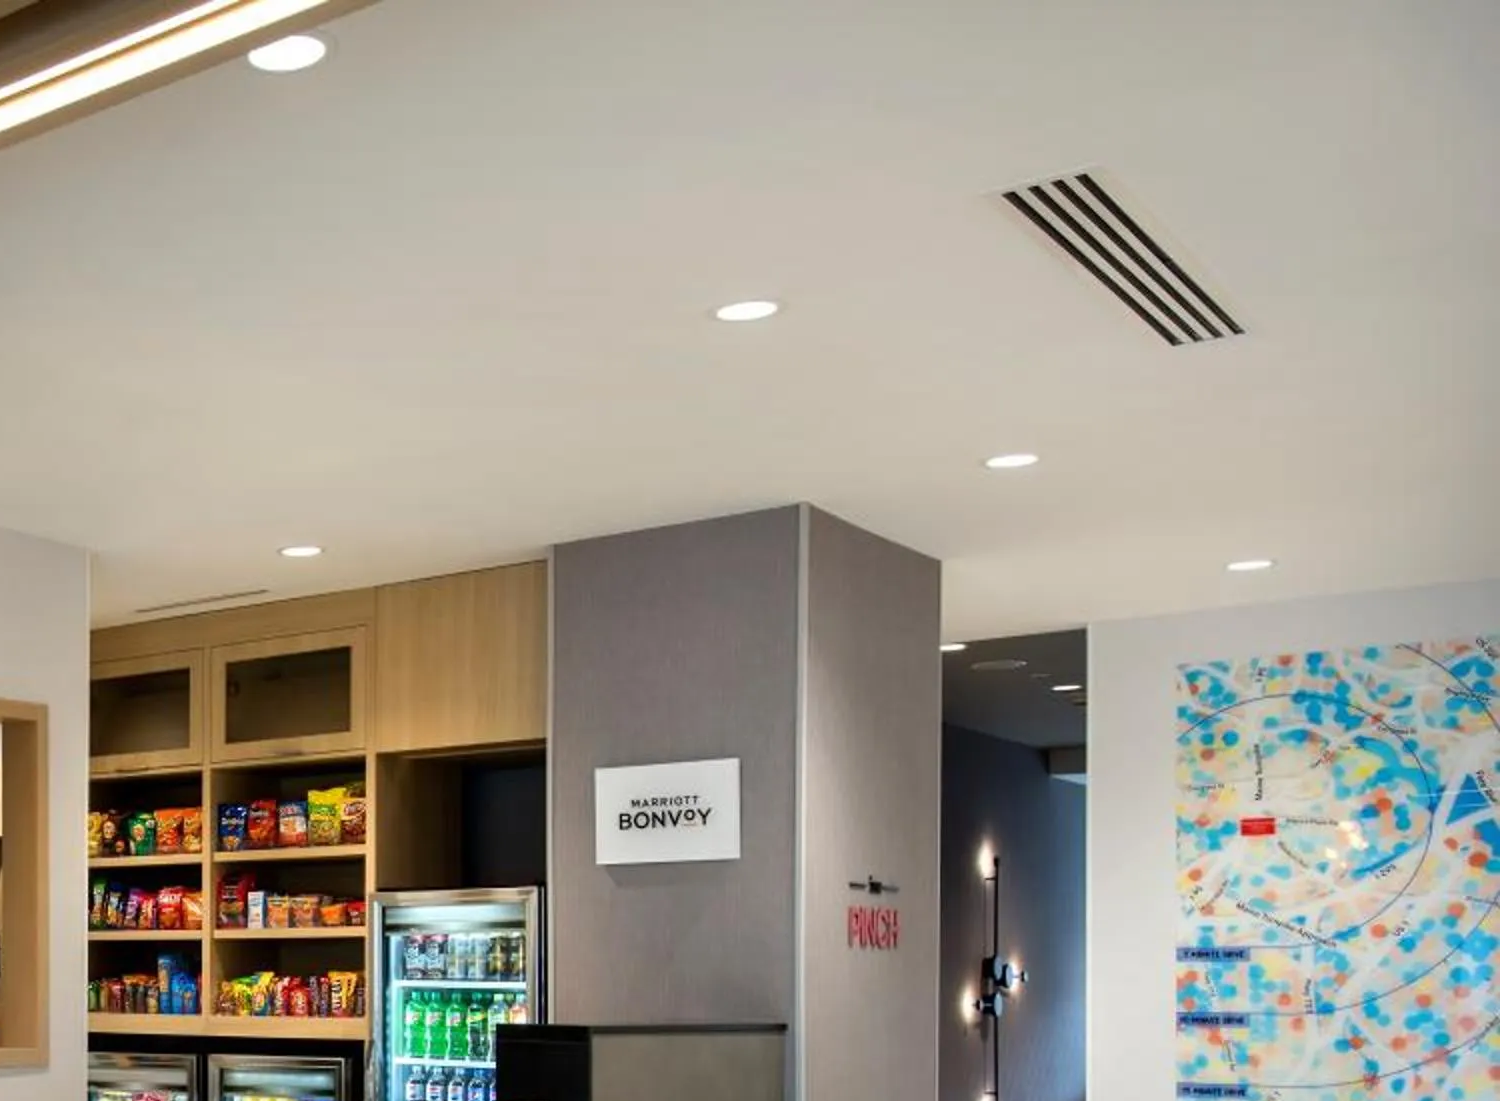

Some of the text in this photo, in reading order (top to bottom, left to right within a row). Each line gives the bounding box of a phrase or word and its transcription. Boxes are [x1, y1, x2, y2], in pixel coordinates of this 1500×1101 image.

[630, 795, 699, 808] MARRIOTT
[619, 808, 712, 831] BONVOY
[847, 905, 901, 950] PINCH
